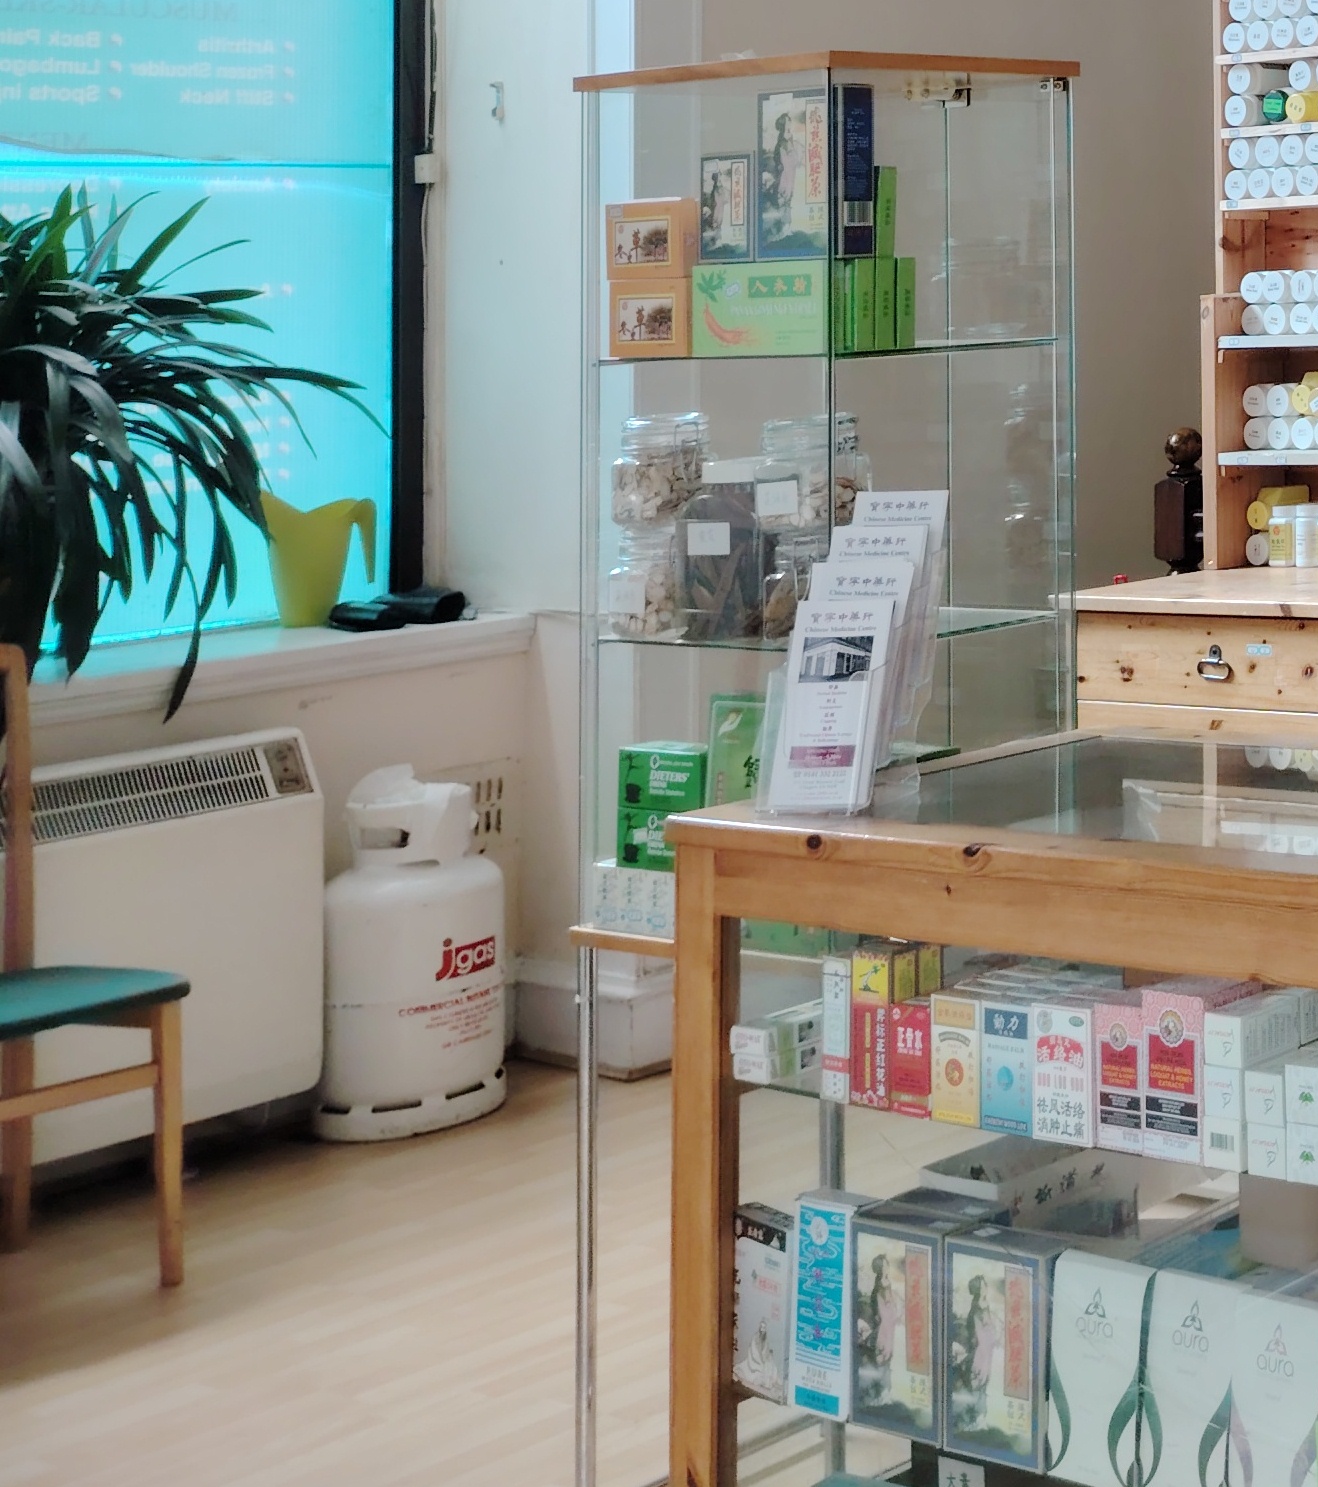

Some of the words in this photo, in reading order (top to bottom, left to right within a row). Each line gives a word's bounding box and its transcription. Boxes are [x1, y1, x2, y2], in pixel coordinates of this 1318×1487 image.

[435, 937, 495, 981] jgas
[1075, 1316, 1114, 1339] aura
[1172, 1328, 1210, 1353] aura
[1256, 1353, 1295, 1378] aura
